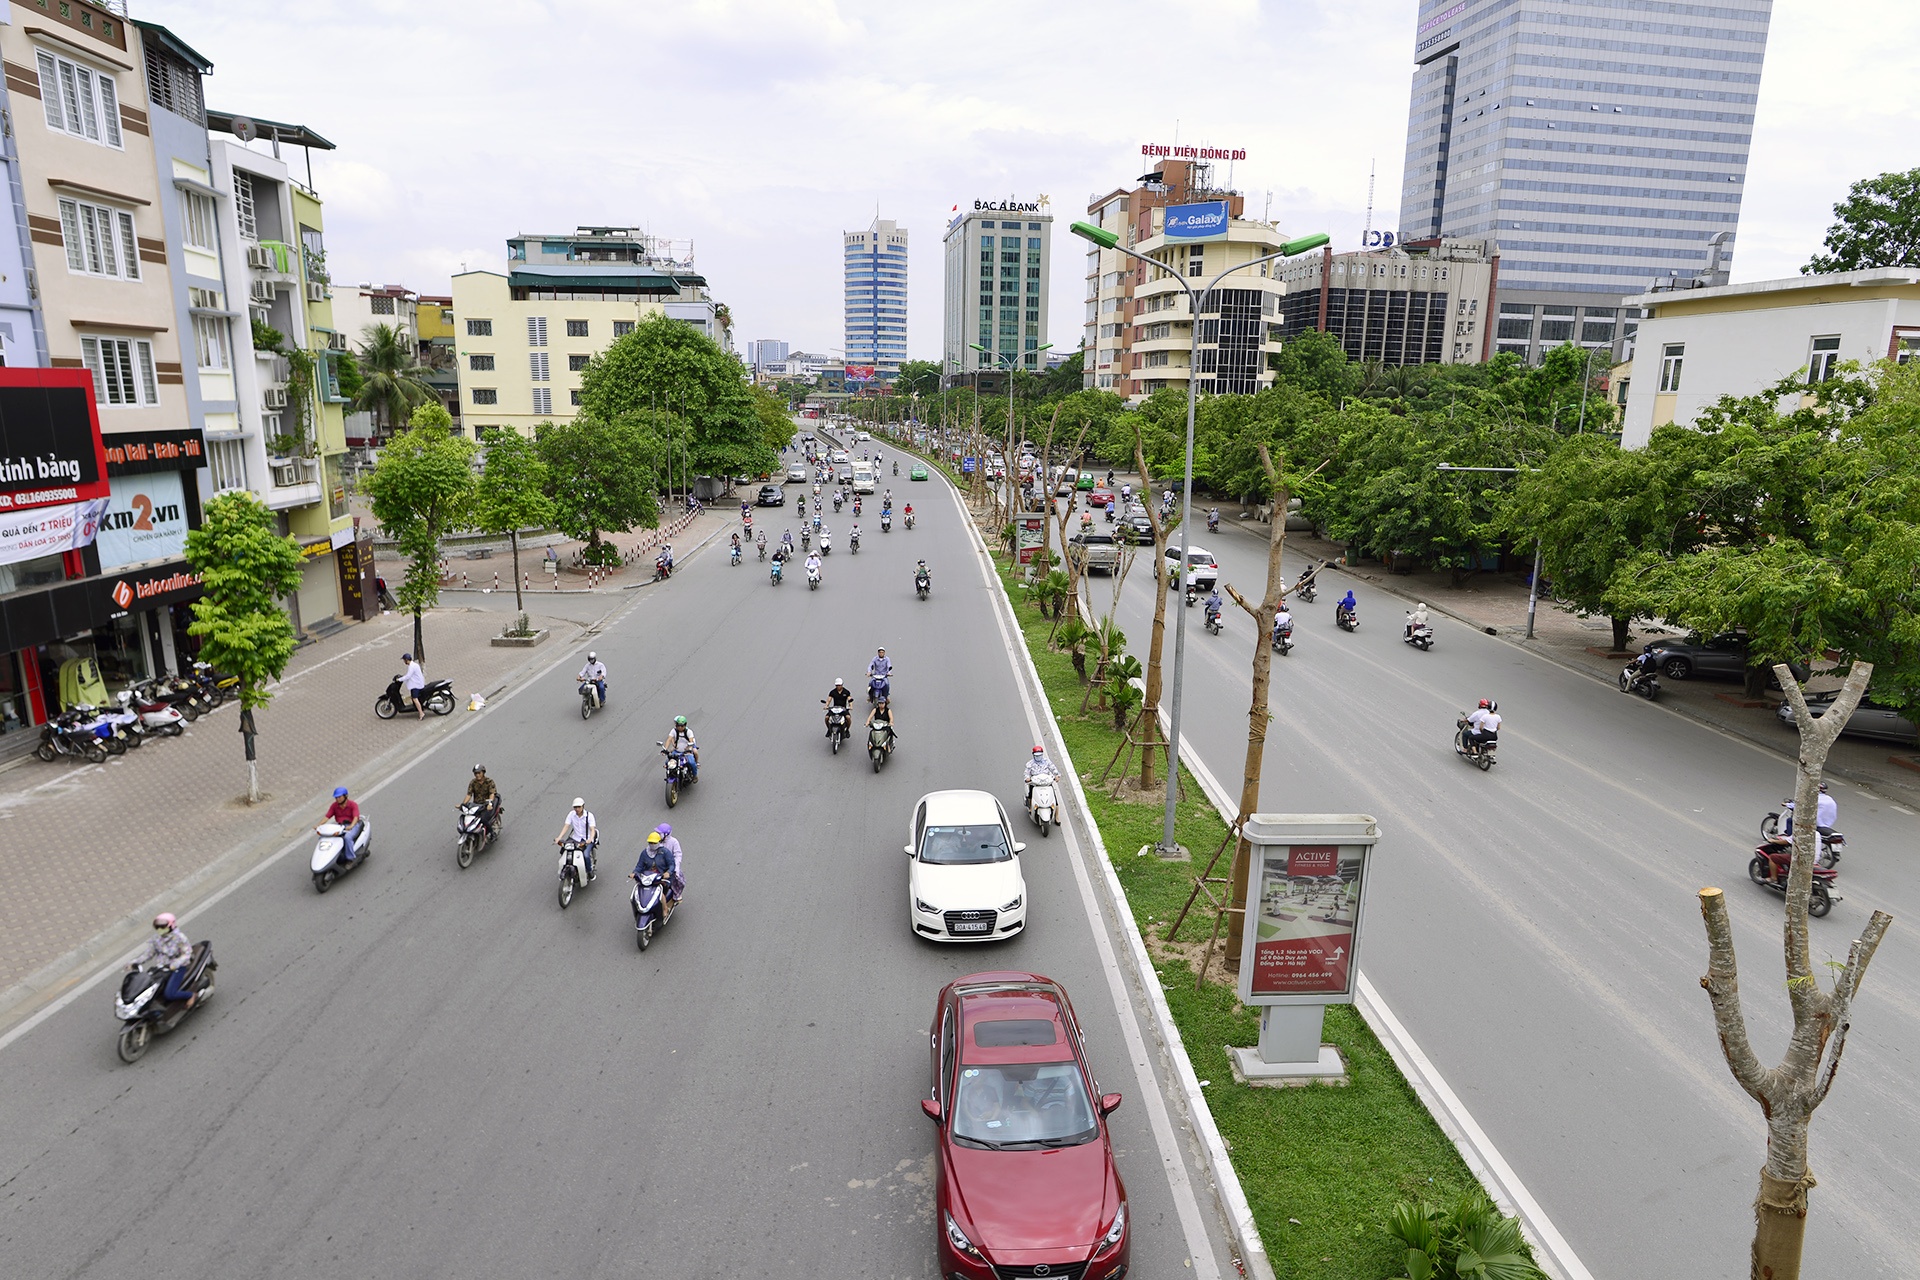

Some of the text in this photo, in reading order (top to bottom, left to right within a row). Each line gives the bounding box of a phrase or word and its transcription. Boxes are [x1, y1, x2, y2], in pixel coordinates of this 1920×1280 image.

[1419, 18, 1440, 33] OFFICE
[1447, 3, 1466, 18] LEASE
[1141, 142, 1171, 158] BỆNH
[1173, 144, 1198, 160] VIỆN
[1200, 146, 1230, 160] ĐÔNG
[1009, 203, 1039, 213] BANK
[1187, 213, 1223, 226] Galaxy
[124, 443, 148, 461] Vali
[153, 441, 180, 459] Balo
[0, 452, 81, 482] tính bảng
[2, 525, 21, 538] QUÀ
[22, 521, 39, 535] ĐẾN
[40, 523, 46, 532] 2
[48, 515, 73, 531] TRIỆU
[136, 571, 206, 599] baloonline.c
[1295, 852, 1331, 861] ACTIVE
